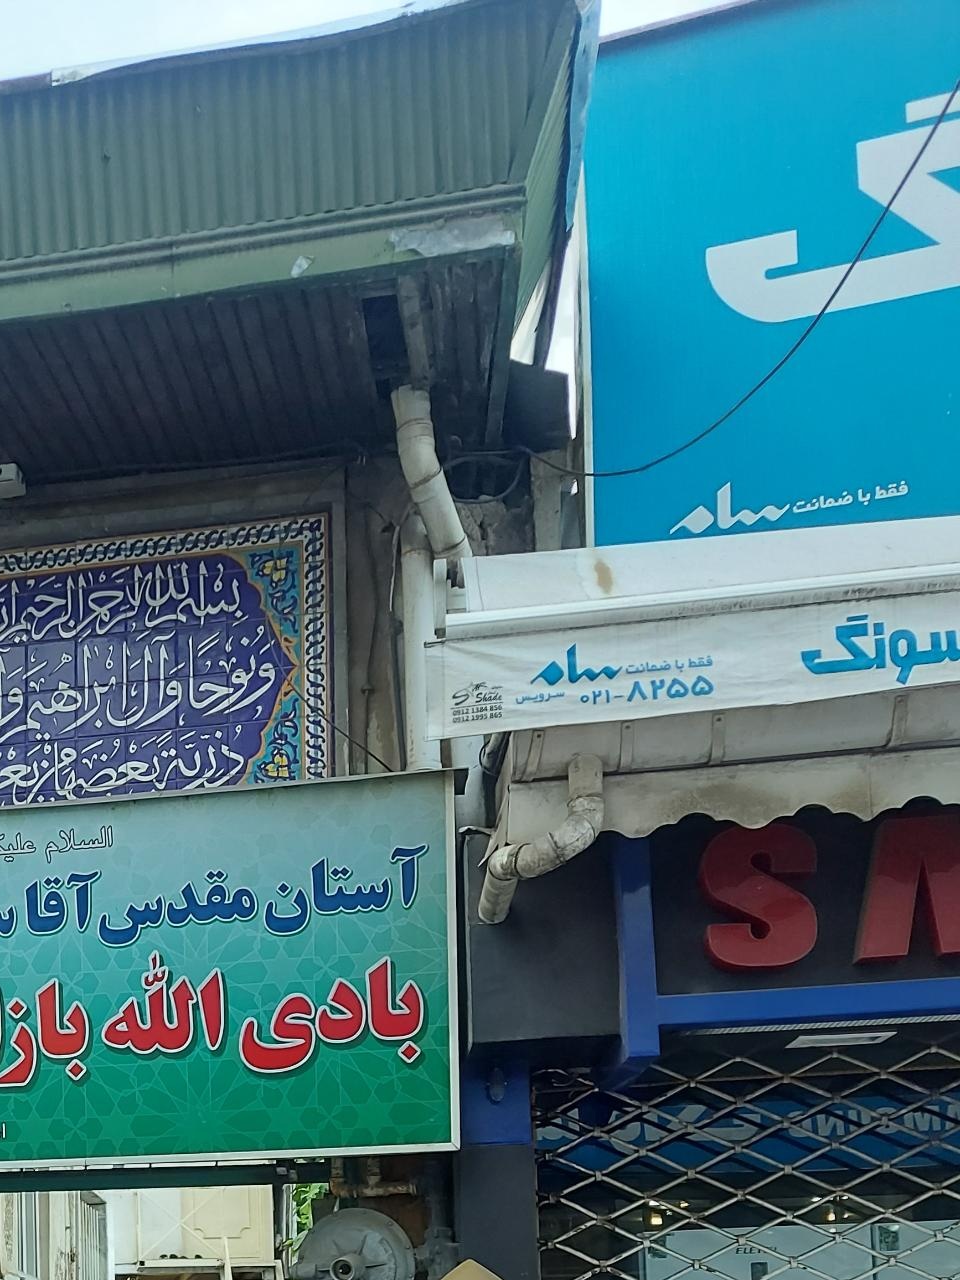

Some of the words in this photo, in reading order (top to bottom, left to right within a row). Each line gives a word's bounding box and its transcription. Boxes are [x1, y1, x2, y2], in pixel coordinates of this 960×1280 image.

[669, 481, 791, 535] سام
[792, 491, 853, 514] ضمانت
[857, 488, 871, 506] با
[874, 480, 909, 500] فقط
[530, 643, 623, 687] سام
[625, 661, 671, 675] ضمانت
[675, 659, 685, 670] با
[688, 656, 714, 668] فقط
[515, 691, 565, 705] سرویس
[45, 826, 113, 863] السلام
[24, 869, 102, 936] آقا
[98, 869, 258, 947] مقدس
[264, 844, 429, 936] آستان
[101, 950, 227, 1055] الله
[240, 956, 426, 1076] بادی
